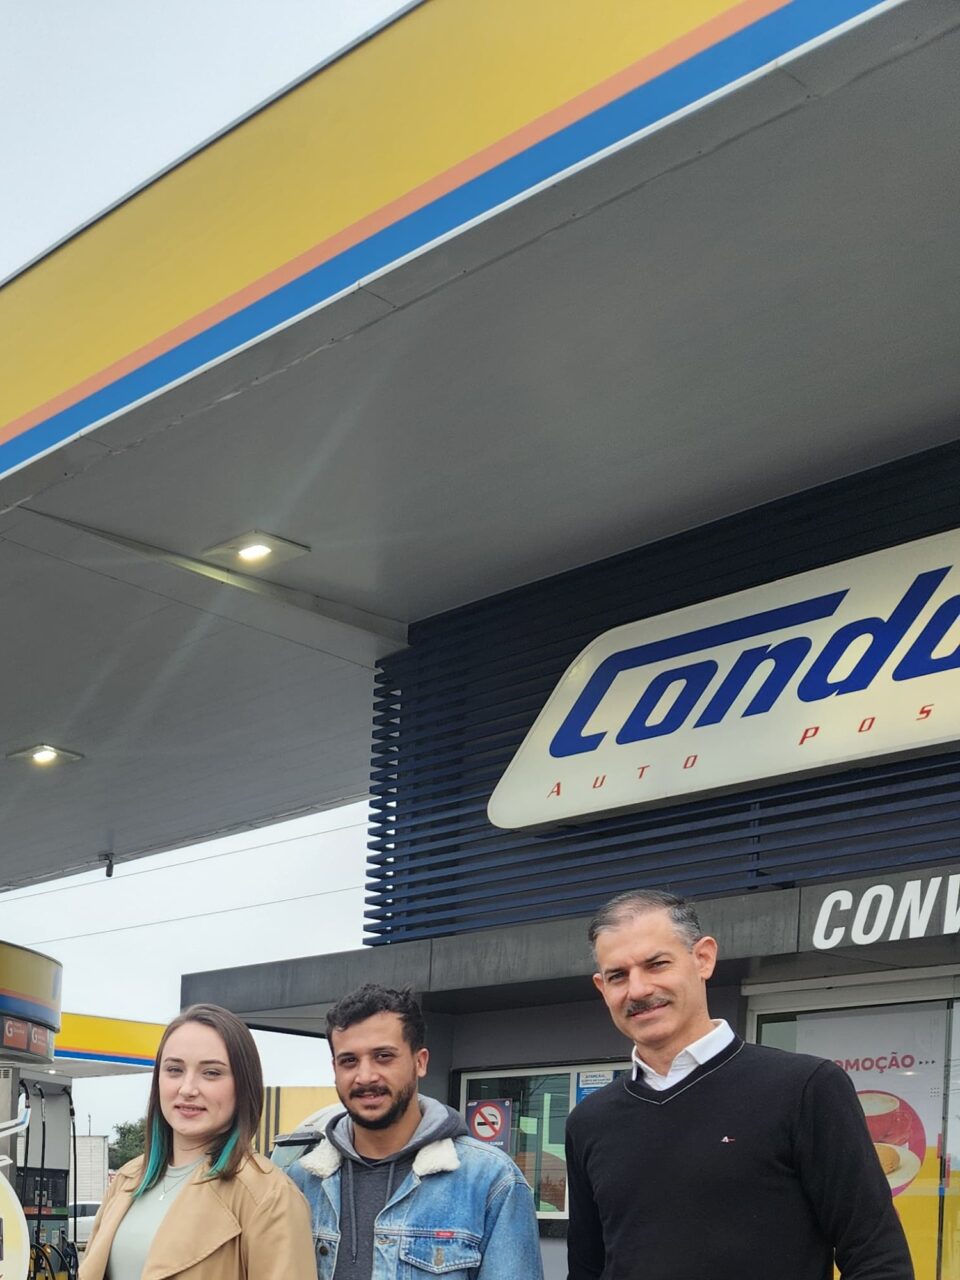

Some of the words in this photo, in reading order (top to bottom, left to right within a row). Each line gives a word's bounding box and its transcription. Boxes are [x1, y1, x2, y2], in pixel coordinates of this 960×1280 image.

[549, 566, 960, 758] Condo
[547, 755, 698, 798] AUTO
[798, 704, 935, 746] POS
